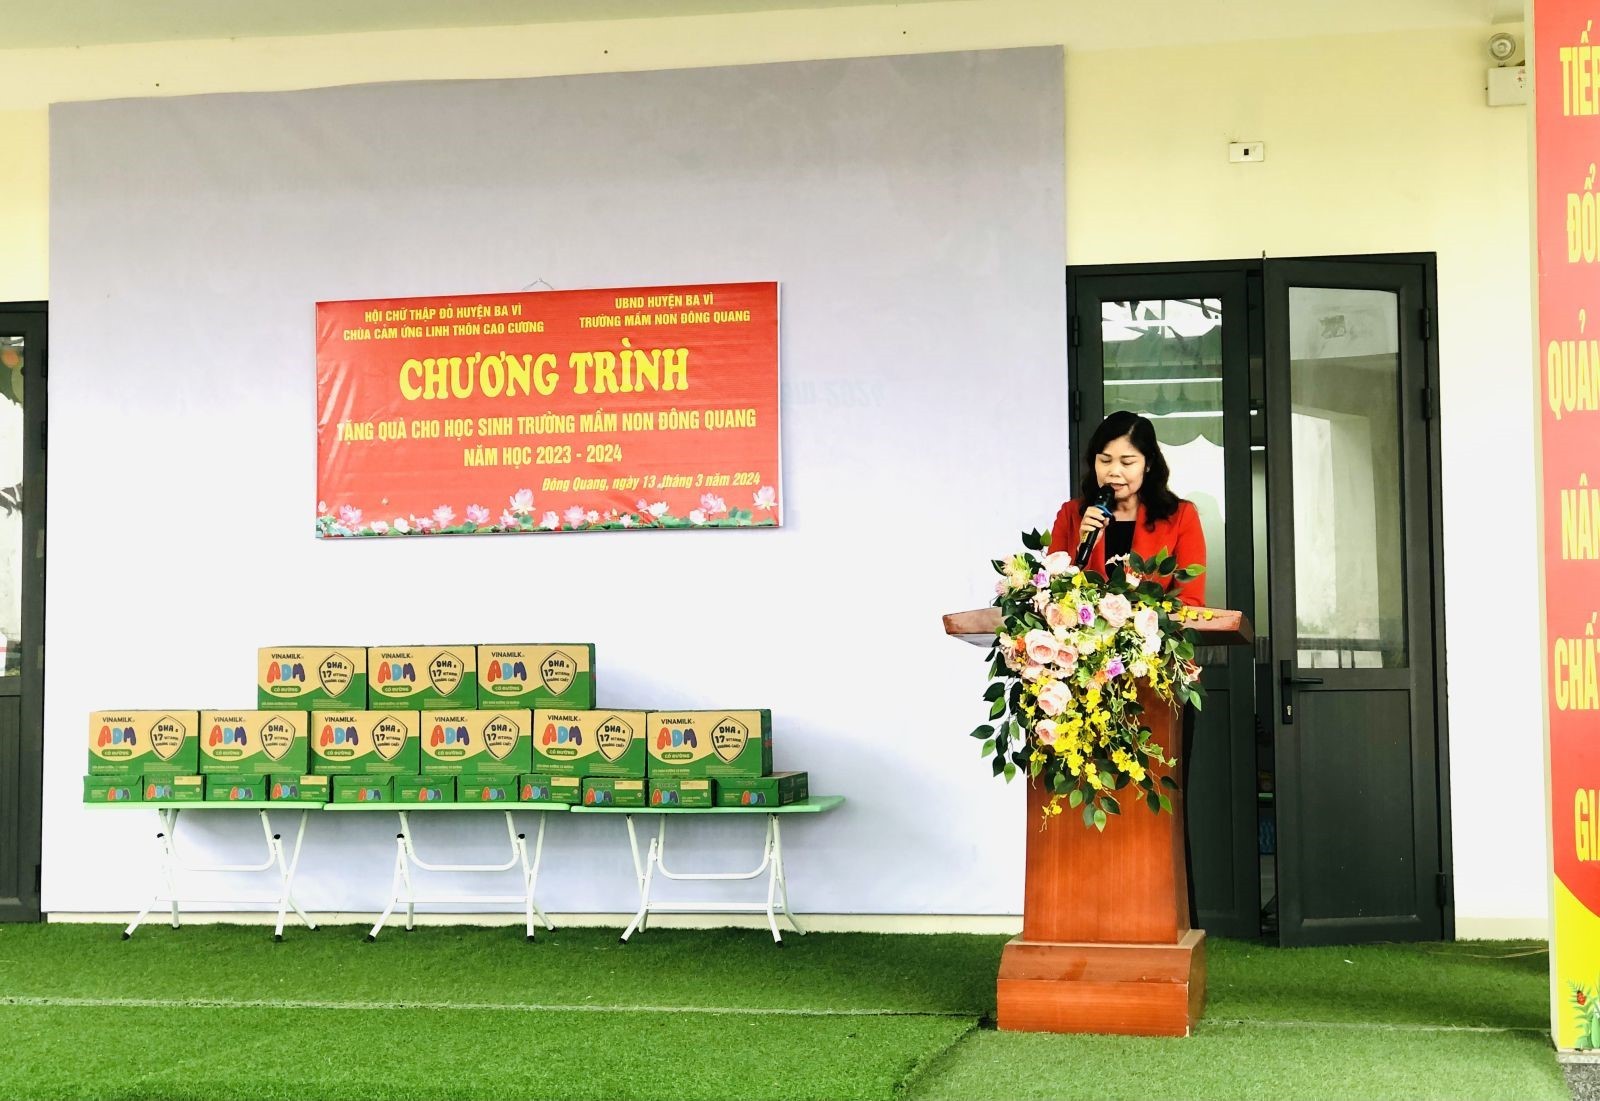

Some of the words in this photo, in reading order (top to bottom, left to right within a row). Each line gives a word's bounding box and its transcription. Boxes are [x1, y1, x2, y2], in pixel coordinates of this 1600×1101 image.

[615, 297, 644, 309] UBND
[647, 294, 683, 310] HUYỆN
[685, 294, 700, 307] BA
[703, 291, 714, 306] VÌ
[364, 308, 382, 324] HỘI
[385, 307, 408, 322] CHỮ
[409, 306, 436, 322] THẬP
[438, 304, 454, 320] ĐỎ
[456, 304, 491, 321] HUYỆN
[494, 305, 509, 317] BA
[511, 302, 522, 316] VÌ
[579, 313, 622, 328] TRƯỜNG
[654, 313, 678, 326] NON
[680, 310, 710, 325] ĐÔNG
[713, 310, 750, 324] QUANG
[343, 326, 371, 341] CHÙA
[374, 323, 398, 340] CẢM
[400, 324, 423, 339] ỨNG
[425, 325, 450, 337] LINH
[452, 322, 481, 336] THÔN
[483, 323, 505, 335] CAO
[400, 350, 560, 400] CHƯƠNG
[569, 337, 689, 395] TRÌNH
[336, 419, 374, 445] TẶNG
[378, 417, 407, 442] QUÀ
[411, 419, 440, 439] CHO
[444, 418, 474, 442] HỌC
[478, 416, 513, 436] SINH
[517, 411, 575, 436] TRƯỜNG
[580, 407, 618, 433] MẦM
[622, 411, 654, 432] NON
[658, 408, 700, 431] ĐÔNG
[704, 408, 757, 431] QUANG
[464, 444, 498, 467] NĂM
[502, 446, 532, 470] HỌC
[536, 445, 572, 465] 2023
[586, 443, 622, 463] 2024
[542, 476, 570, 492] Đông
[572, 476, 609, 492] Quang,
[612, 475, 640, 490] ngày
[642, 475, 656, 489] 13
[695, 474, 703, 487] 3
[705, 472, 730, 486] năm
[732, 472, 761, 486] 2024
[436, 660, 452, 668] DHA
[548, 660, 564, 668] DHA
[1554, 611, 1600, 711] CHẤ
[322, 670, 332, 678] 17
[544, 669, 554, 677] 17
[158, 724, 174, 732] DHA
[491, 724, 507, 732] DHA
[719, 726, 736, 734] DHA
[263, 734, 274, 742] 17
[375, 734, 386, 742] 17
[486, 733, 496, 742] 17
[600, 734, 610, 742] 17
[715, 736, 725, 744] 17
[1574, 788, 1600, 862] GI
